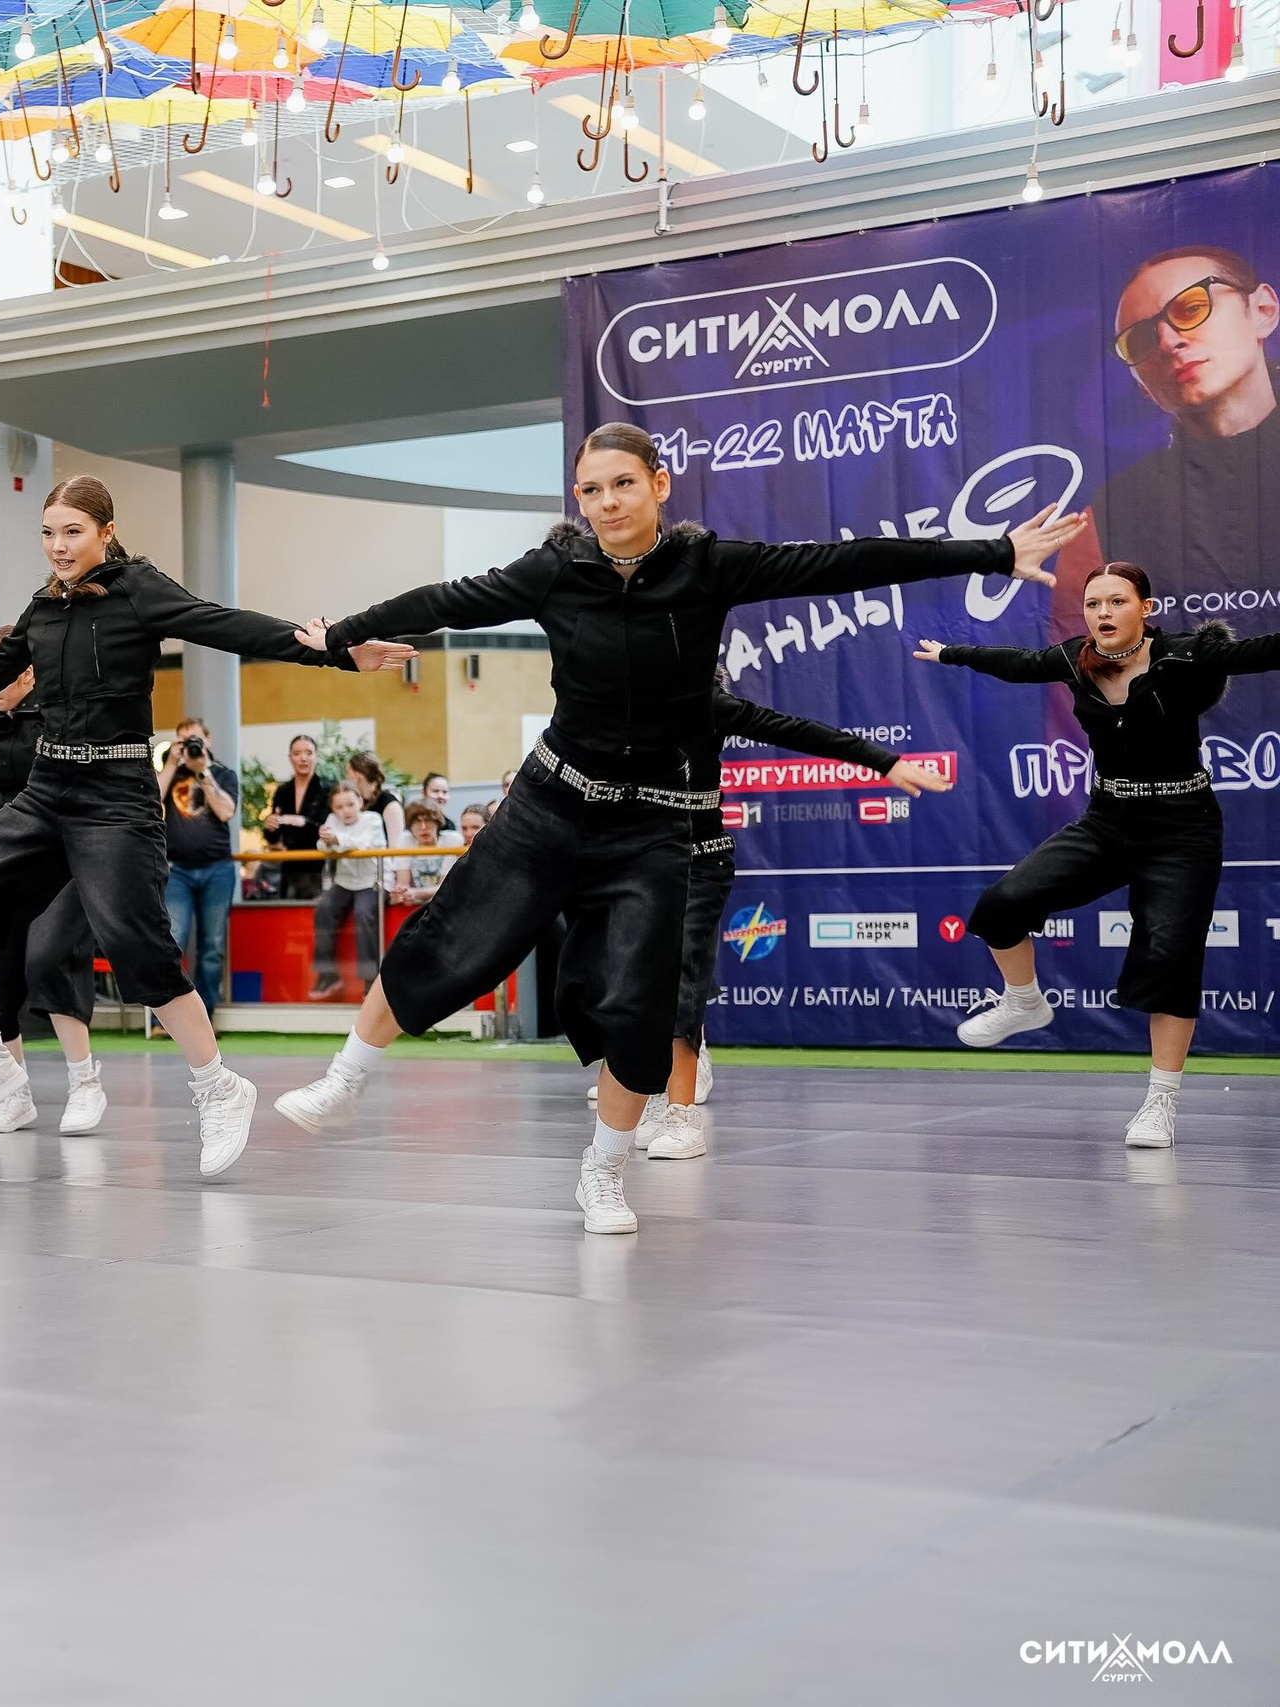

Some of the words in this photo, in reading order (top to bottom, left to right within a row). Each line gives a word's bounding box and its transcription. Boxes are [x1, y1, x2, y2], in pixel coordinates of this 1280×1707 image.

[628, 310, 760, 363] СИТИ
[803, 282, 961, 338] МОЛЛ
[750, 355, 814, 377] СУРГУТ
[793, 392, 958, 462] МАРТА
[1183, 588, 1280, 614] СОКОЛ
[720, 582, 905, 682] АНЦЫ
[772, 803, 852, 823] ТЕЛЕКАНАЛ
[856, 920, 909, 931] синема
[856, 931, 892, 942] парк
[733, 986, 783, 1006] ШОУ
[803, 986, 880, 1006] БАТТЛЫ
[1082, 989, 1120, 1009] ШО
